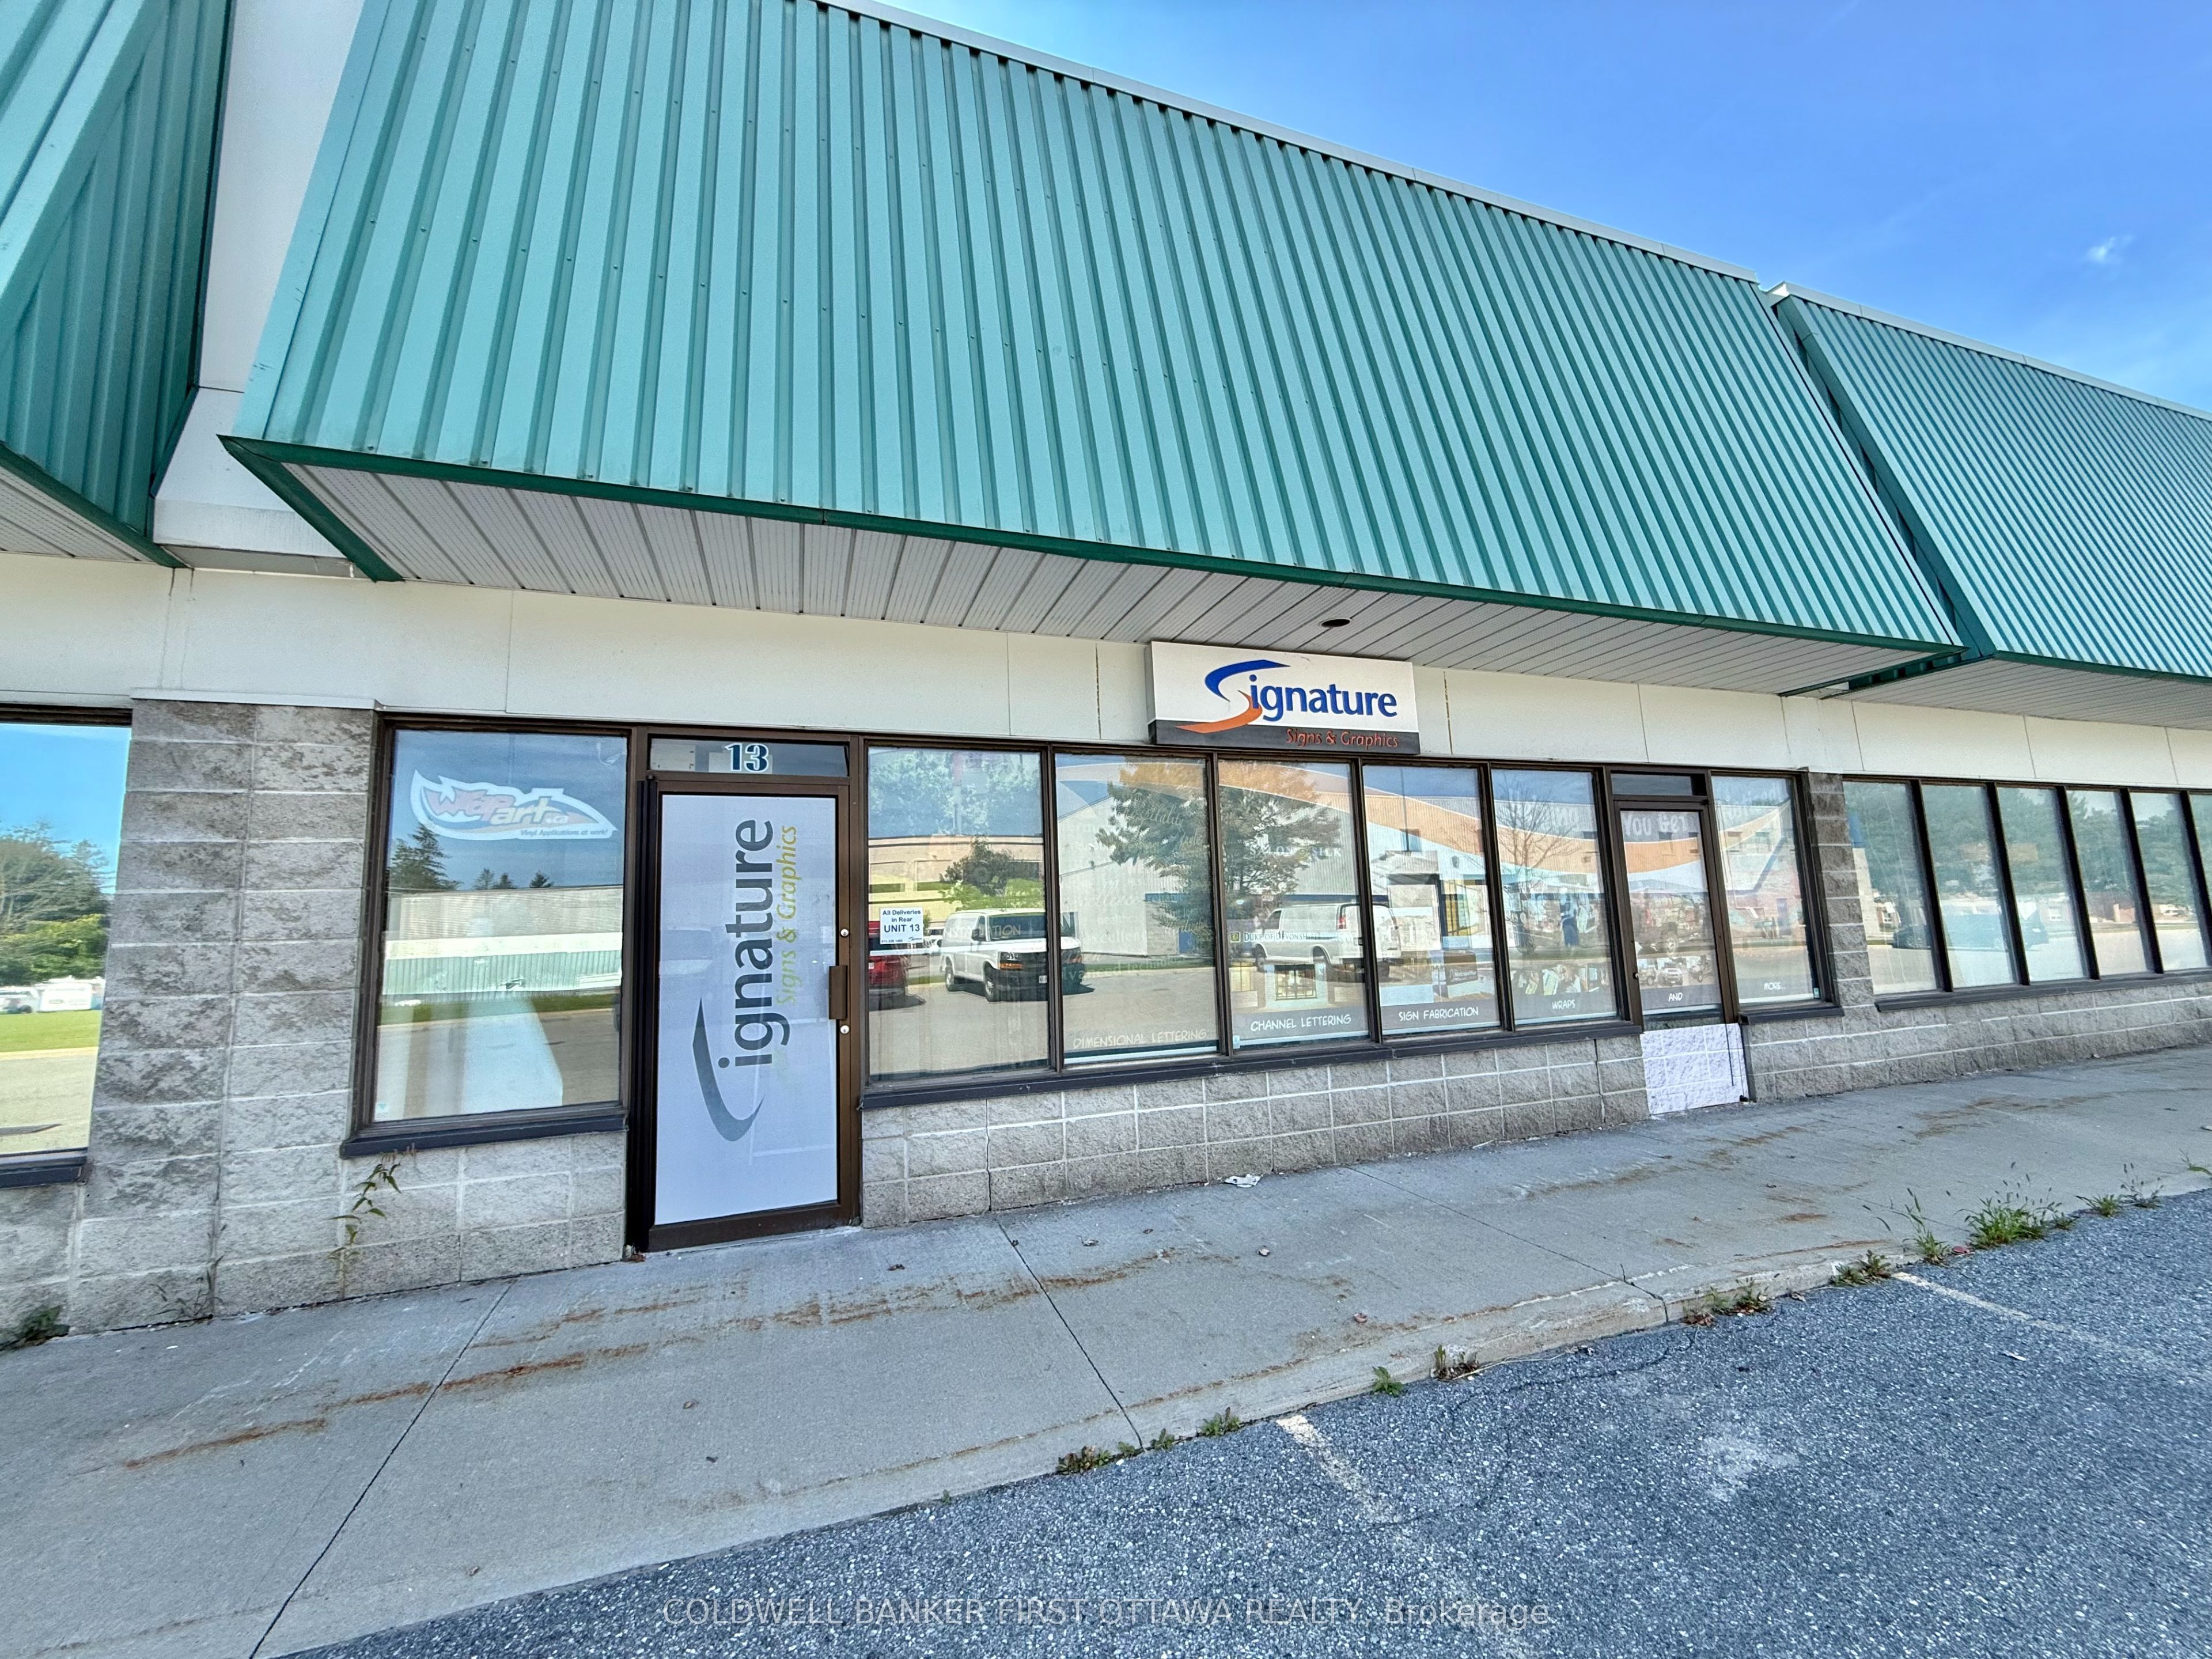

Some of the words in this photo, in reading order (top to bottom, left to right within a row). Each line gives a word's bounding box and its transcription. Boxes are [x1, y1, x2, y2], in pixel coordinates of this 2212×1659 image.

[1175, 659, 1398, 733] Signature
[1286, 728, 1323, 747] Signs
[1325, 731, 1338, 744] &
[1340, 730, 1399, 750] Graphics
[724, 743, 770, 773] 13
[776, 825, 802, 921] Graphics
[783, 928, 797, 945] &
[884, 924, 907, 933] UNIT
[910, 923, 920, 931] 13
[775, 950, 797, 1007] Signs
[1552, 999, 1576, 1010] WRAPS
[1668, 992, 1683, 1001] AND
[1399, 1010, 1419, 1021] SIGN
[1423, 1006, 1479, 1020] FABRICATION
[1251, 1018, 1297, 1032] CHANNEL
[1301, 1014, 1352, 1028] LETTERING
[1073, 1033, 1146, 1048] DIMENSIONAL
[1152, 1029, 1207, 1043] LETTERING
